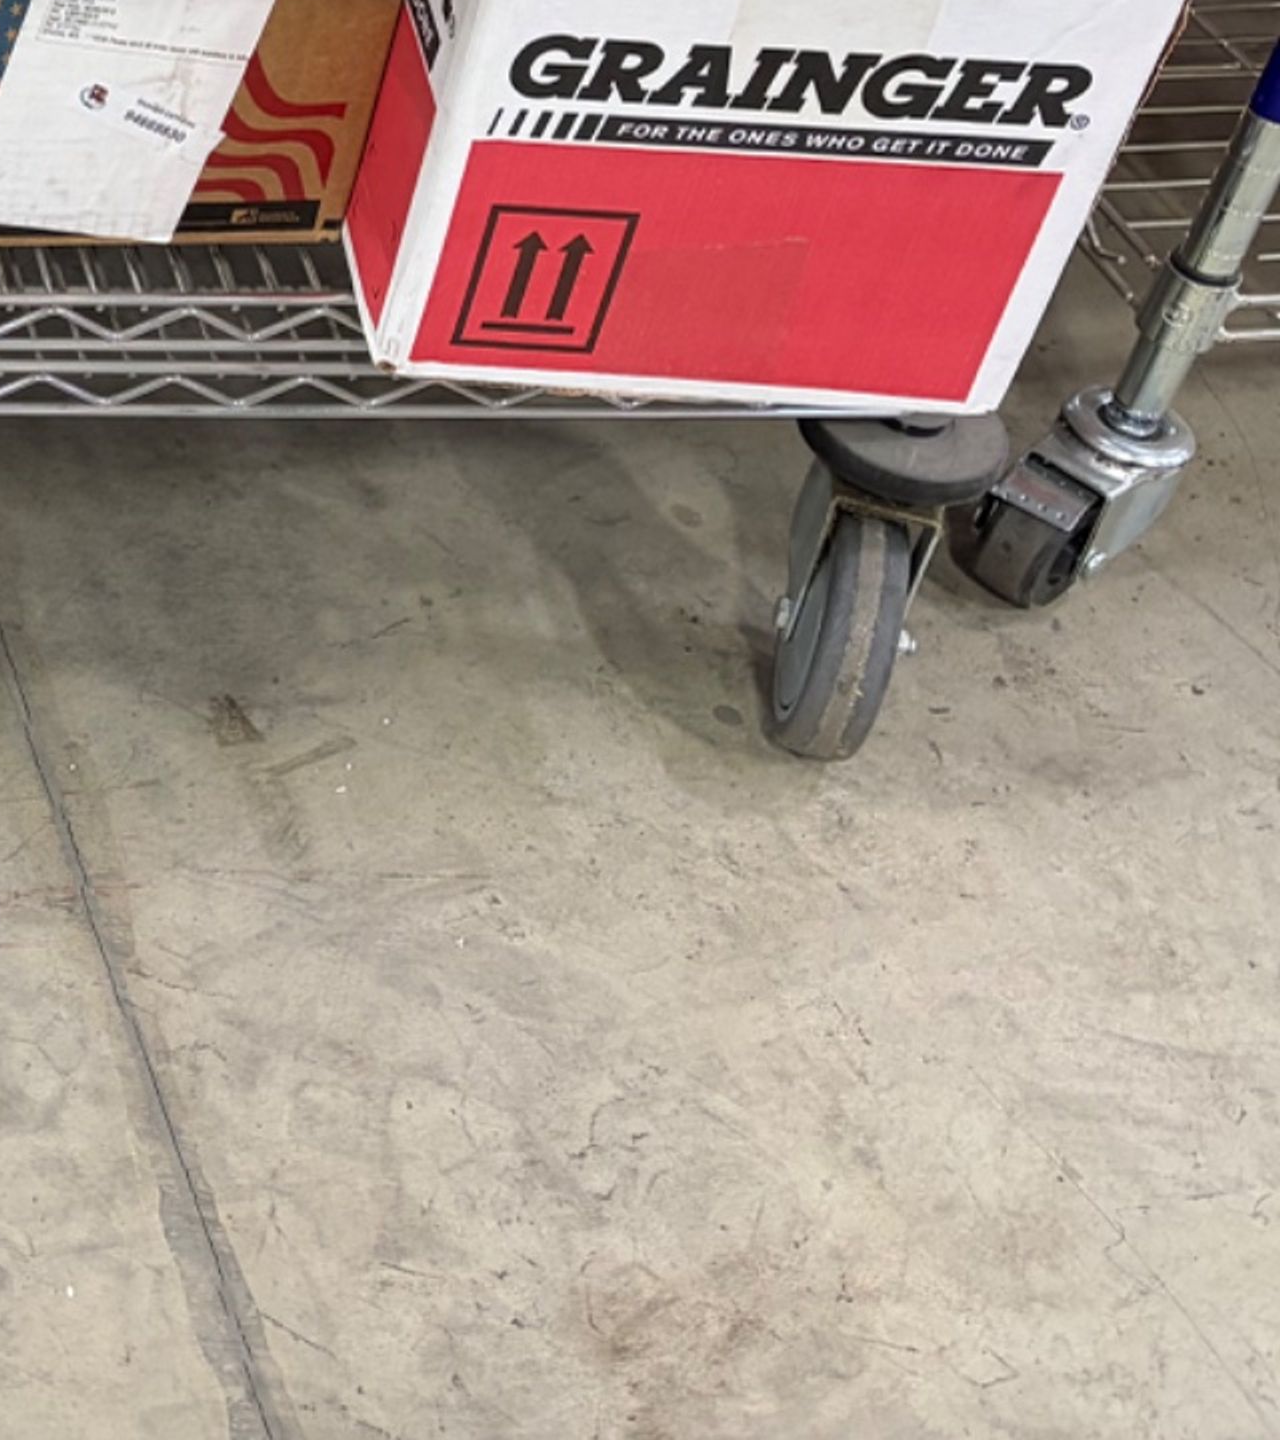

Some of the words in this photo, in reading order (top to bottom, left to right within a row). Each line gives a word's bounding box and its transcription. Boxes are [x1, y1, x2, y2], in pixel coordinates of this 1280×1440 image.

[509, 34, 1093, 130] GRAINGER
[616, 123, 668, 139] FOR
[675, 126, 724, 143] THE
[728, 129, 799, 148] ONES
[805, 133, 865, 151] WHO
[871, 137, 922, 154] GET
[925, 140, 951, 156] IT
[954, 142, 1029, 160] DONE
